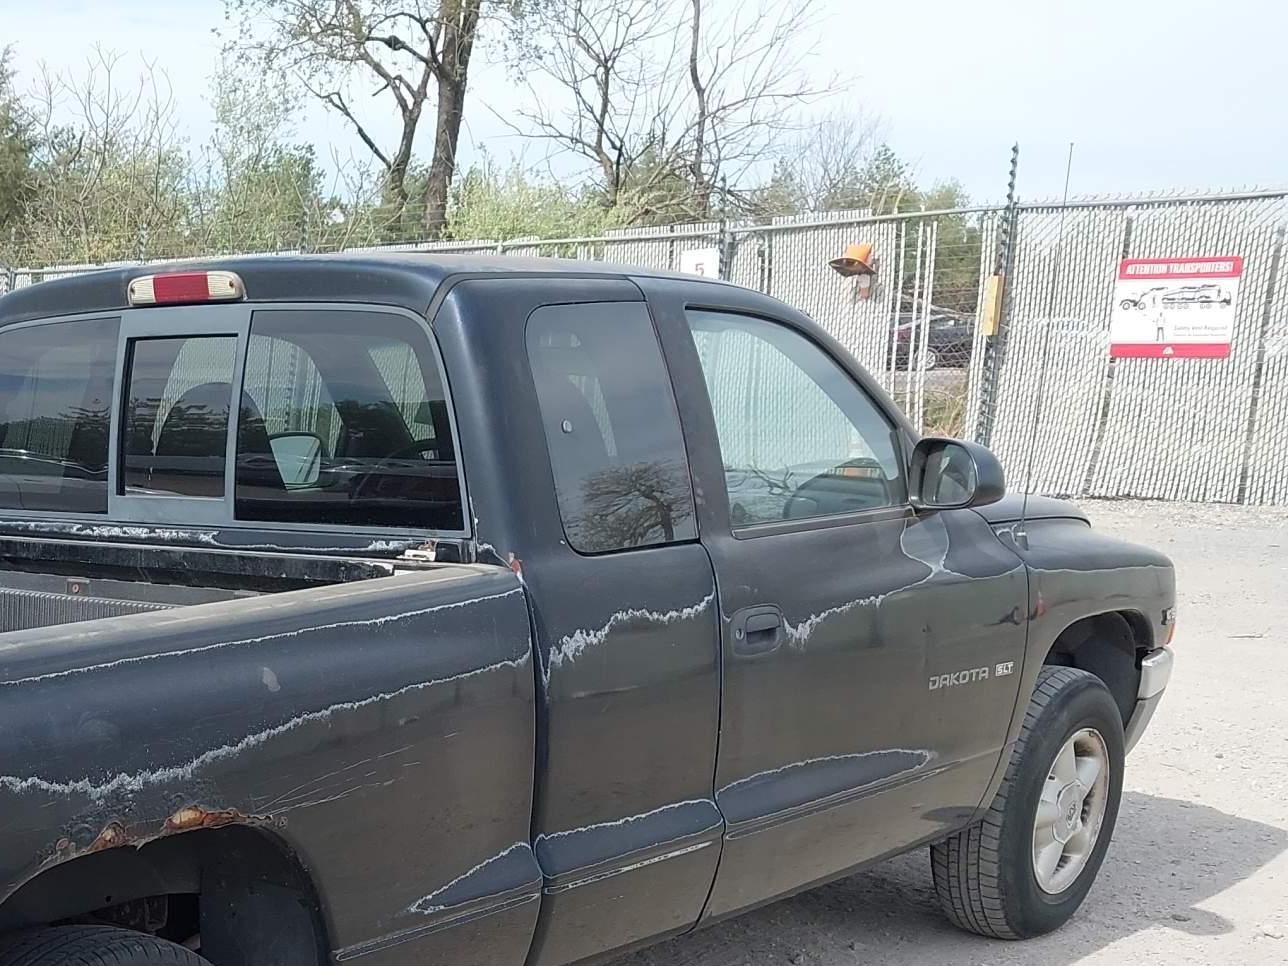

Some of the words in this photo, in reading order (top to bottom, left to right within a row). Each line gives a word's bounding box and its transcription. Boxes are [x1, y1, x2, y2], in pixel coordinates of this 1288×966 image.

[1126, 263, 1168, 275] ATTENTION
[928, 667, 989, 690] DAKOTA
[997, 661, 1013, 675] SLT
